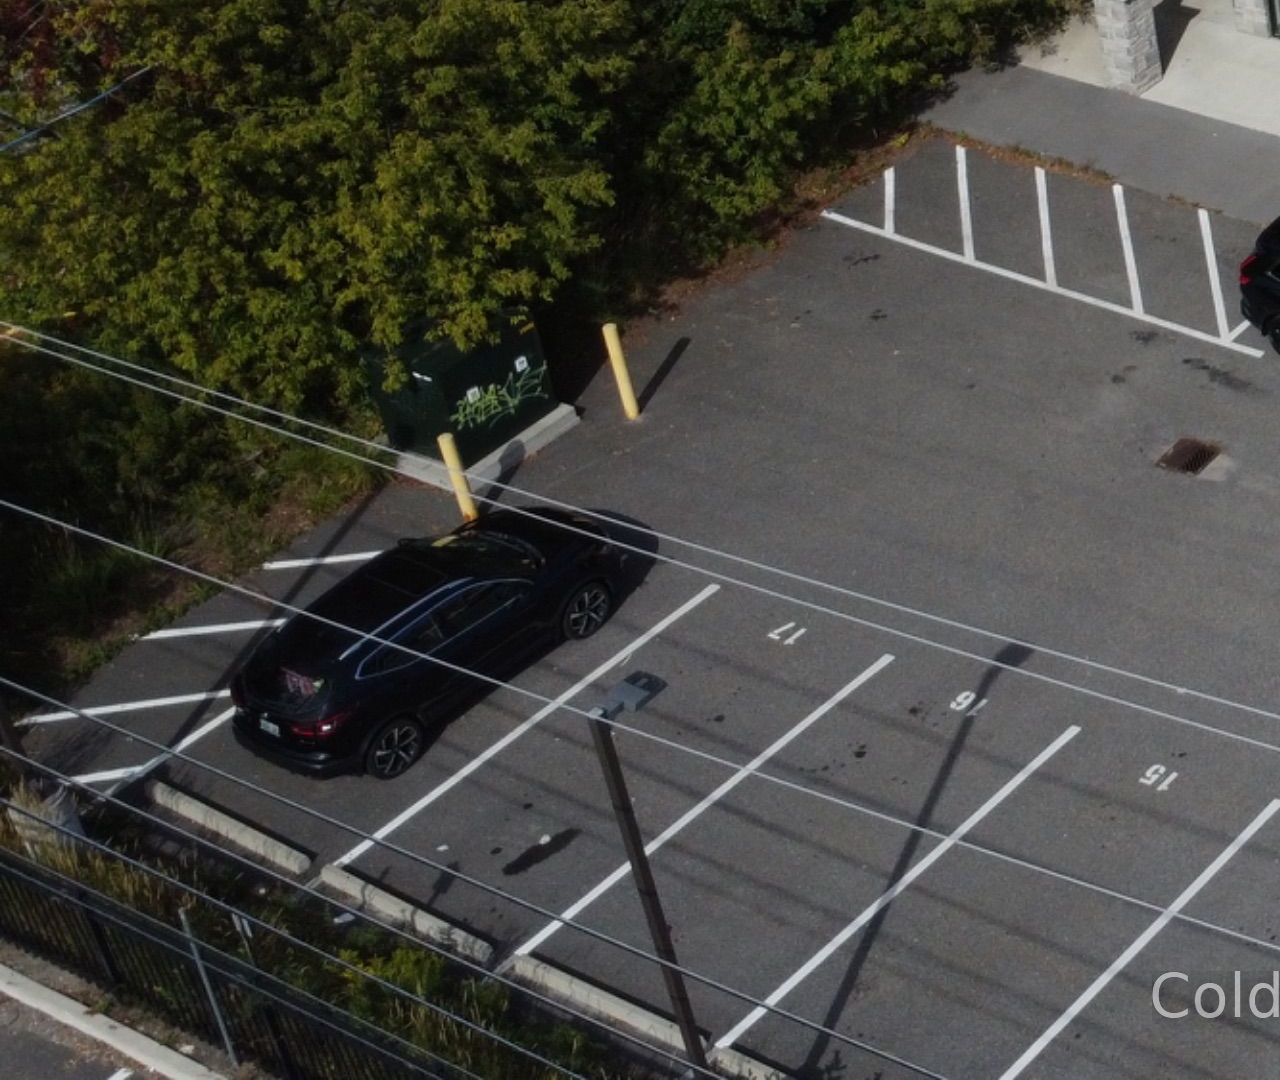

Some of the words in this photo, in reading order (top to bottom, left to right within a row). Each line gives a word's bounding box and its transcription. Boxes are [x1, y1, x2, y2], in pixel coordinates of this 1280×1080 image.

[766, 620, 809, 647] 17
[949, 690, 989, 717] 16
[1137, 763, 1182, 793] 15
